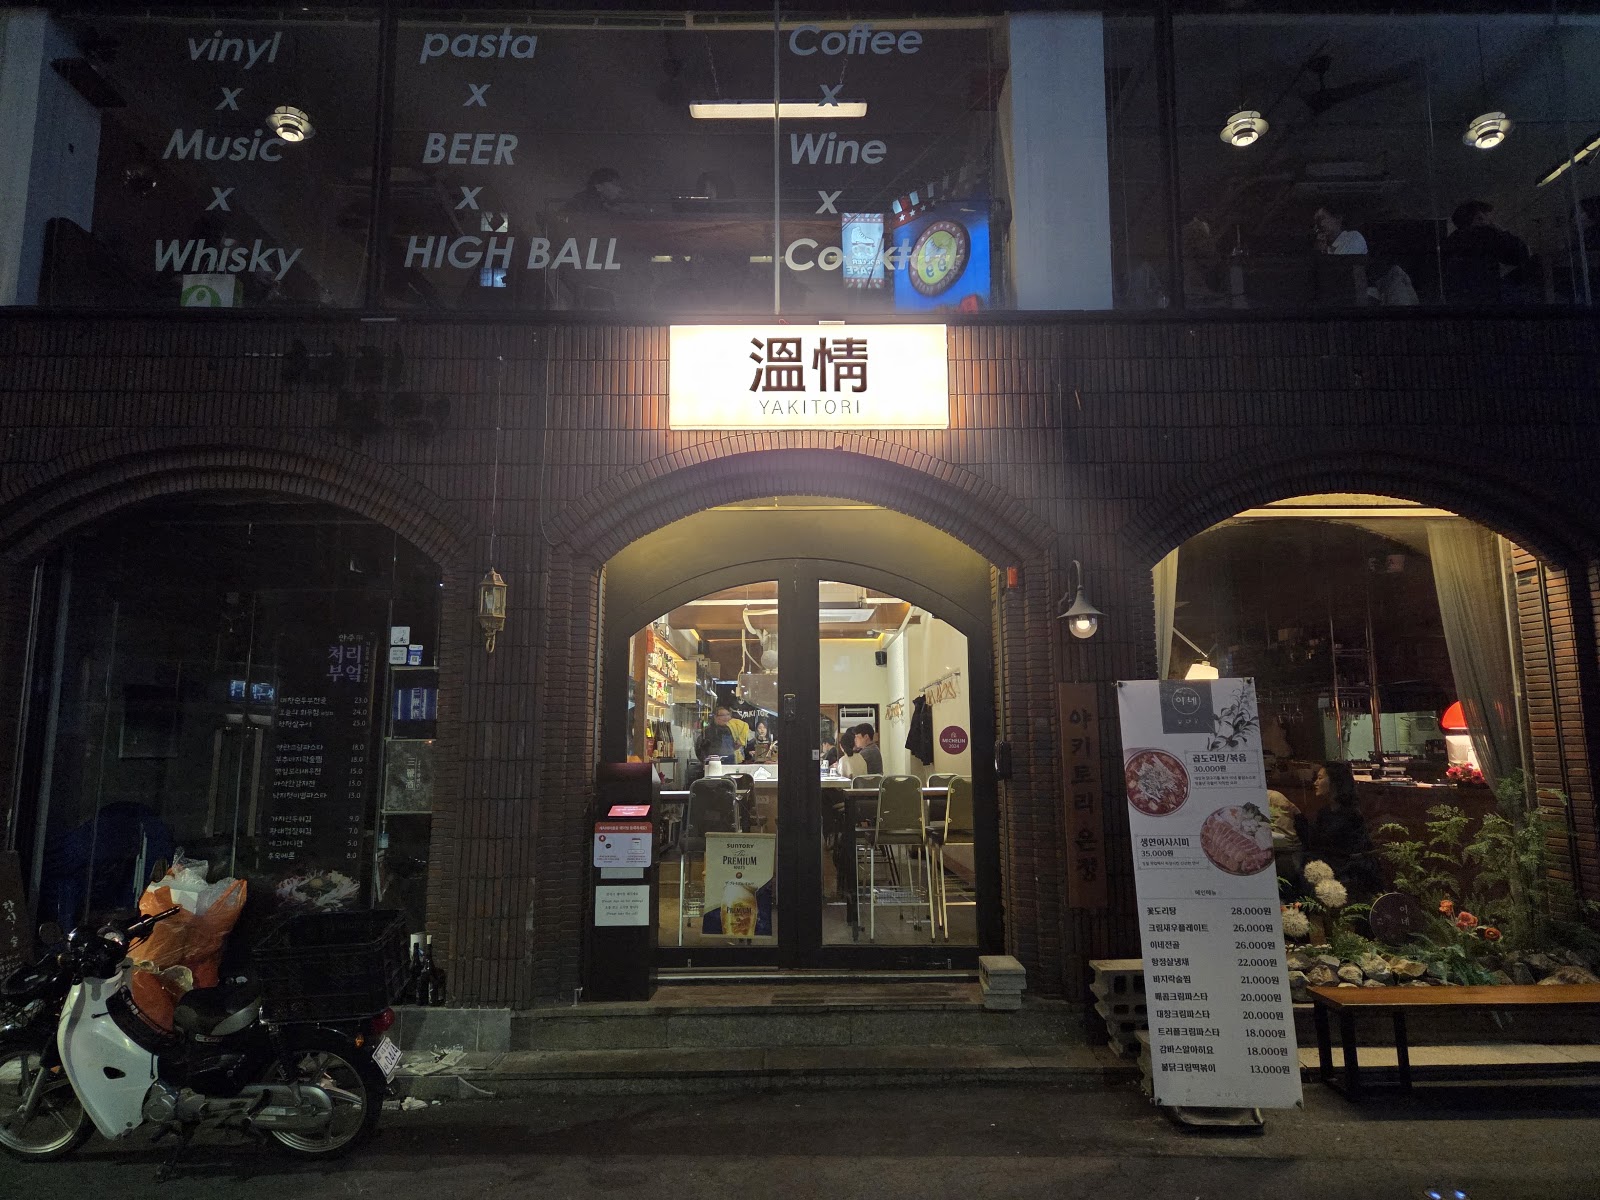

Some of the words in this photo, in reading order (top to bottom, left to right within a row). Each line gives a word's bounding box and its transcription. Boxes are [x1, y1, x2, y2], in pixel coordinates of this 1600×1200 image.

[788, 25, 924, 56] Coffee
[187, 31, 282, 70] vinyl
[419, 28, 539, 64] pasta
[163, 129, 285, 162] Music
[422, 133, 519, 166] BEER
[789, 133, 888, 165] Wine
[404, 235, 514, 270] HIGH
[526, 237, 622, 271] BALL
[155, 238, 303, 281] Whisky
[749, 336, 869, 394] 溫情
[759, 400, 860, 415] YAKITORI
[1140, 838, 1190, 848] 생연어사시미
[722, 856, 757, 866] PREMIUM
[1231, 907, 1271, 915] 28.000원
[1233, 924, 1273, 932] 26.000원
[1235, 941, 1275, 949] 26.000원
[1238, 959, 1277, 967] 22.000원
[1153, 975, 1191, 983] 바지락술찜
[1240, 976, 1279, 984] 21.000원
[1240, 994, 1281, 1002] 20.000원
[1243, 1012, 1283, 1020] 20.000원
[1245, 1029, 1286, 1038] 18.000원
[1247, 1047, 1288, 1056] 18.000원
[1251, 1065, 1290, 1074] 13.000원
